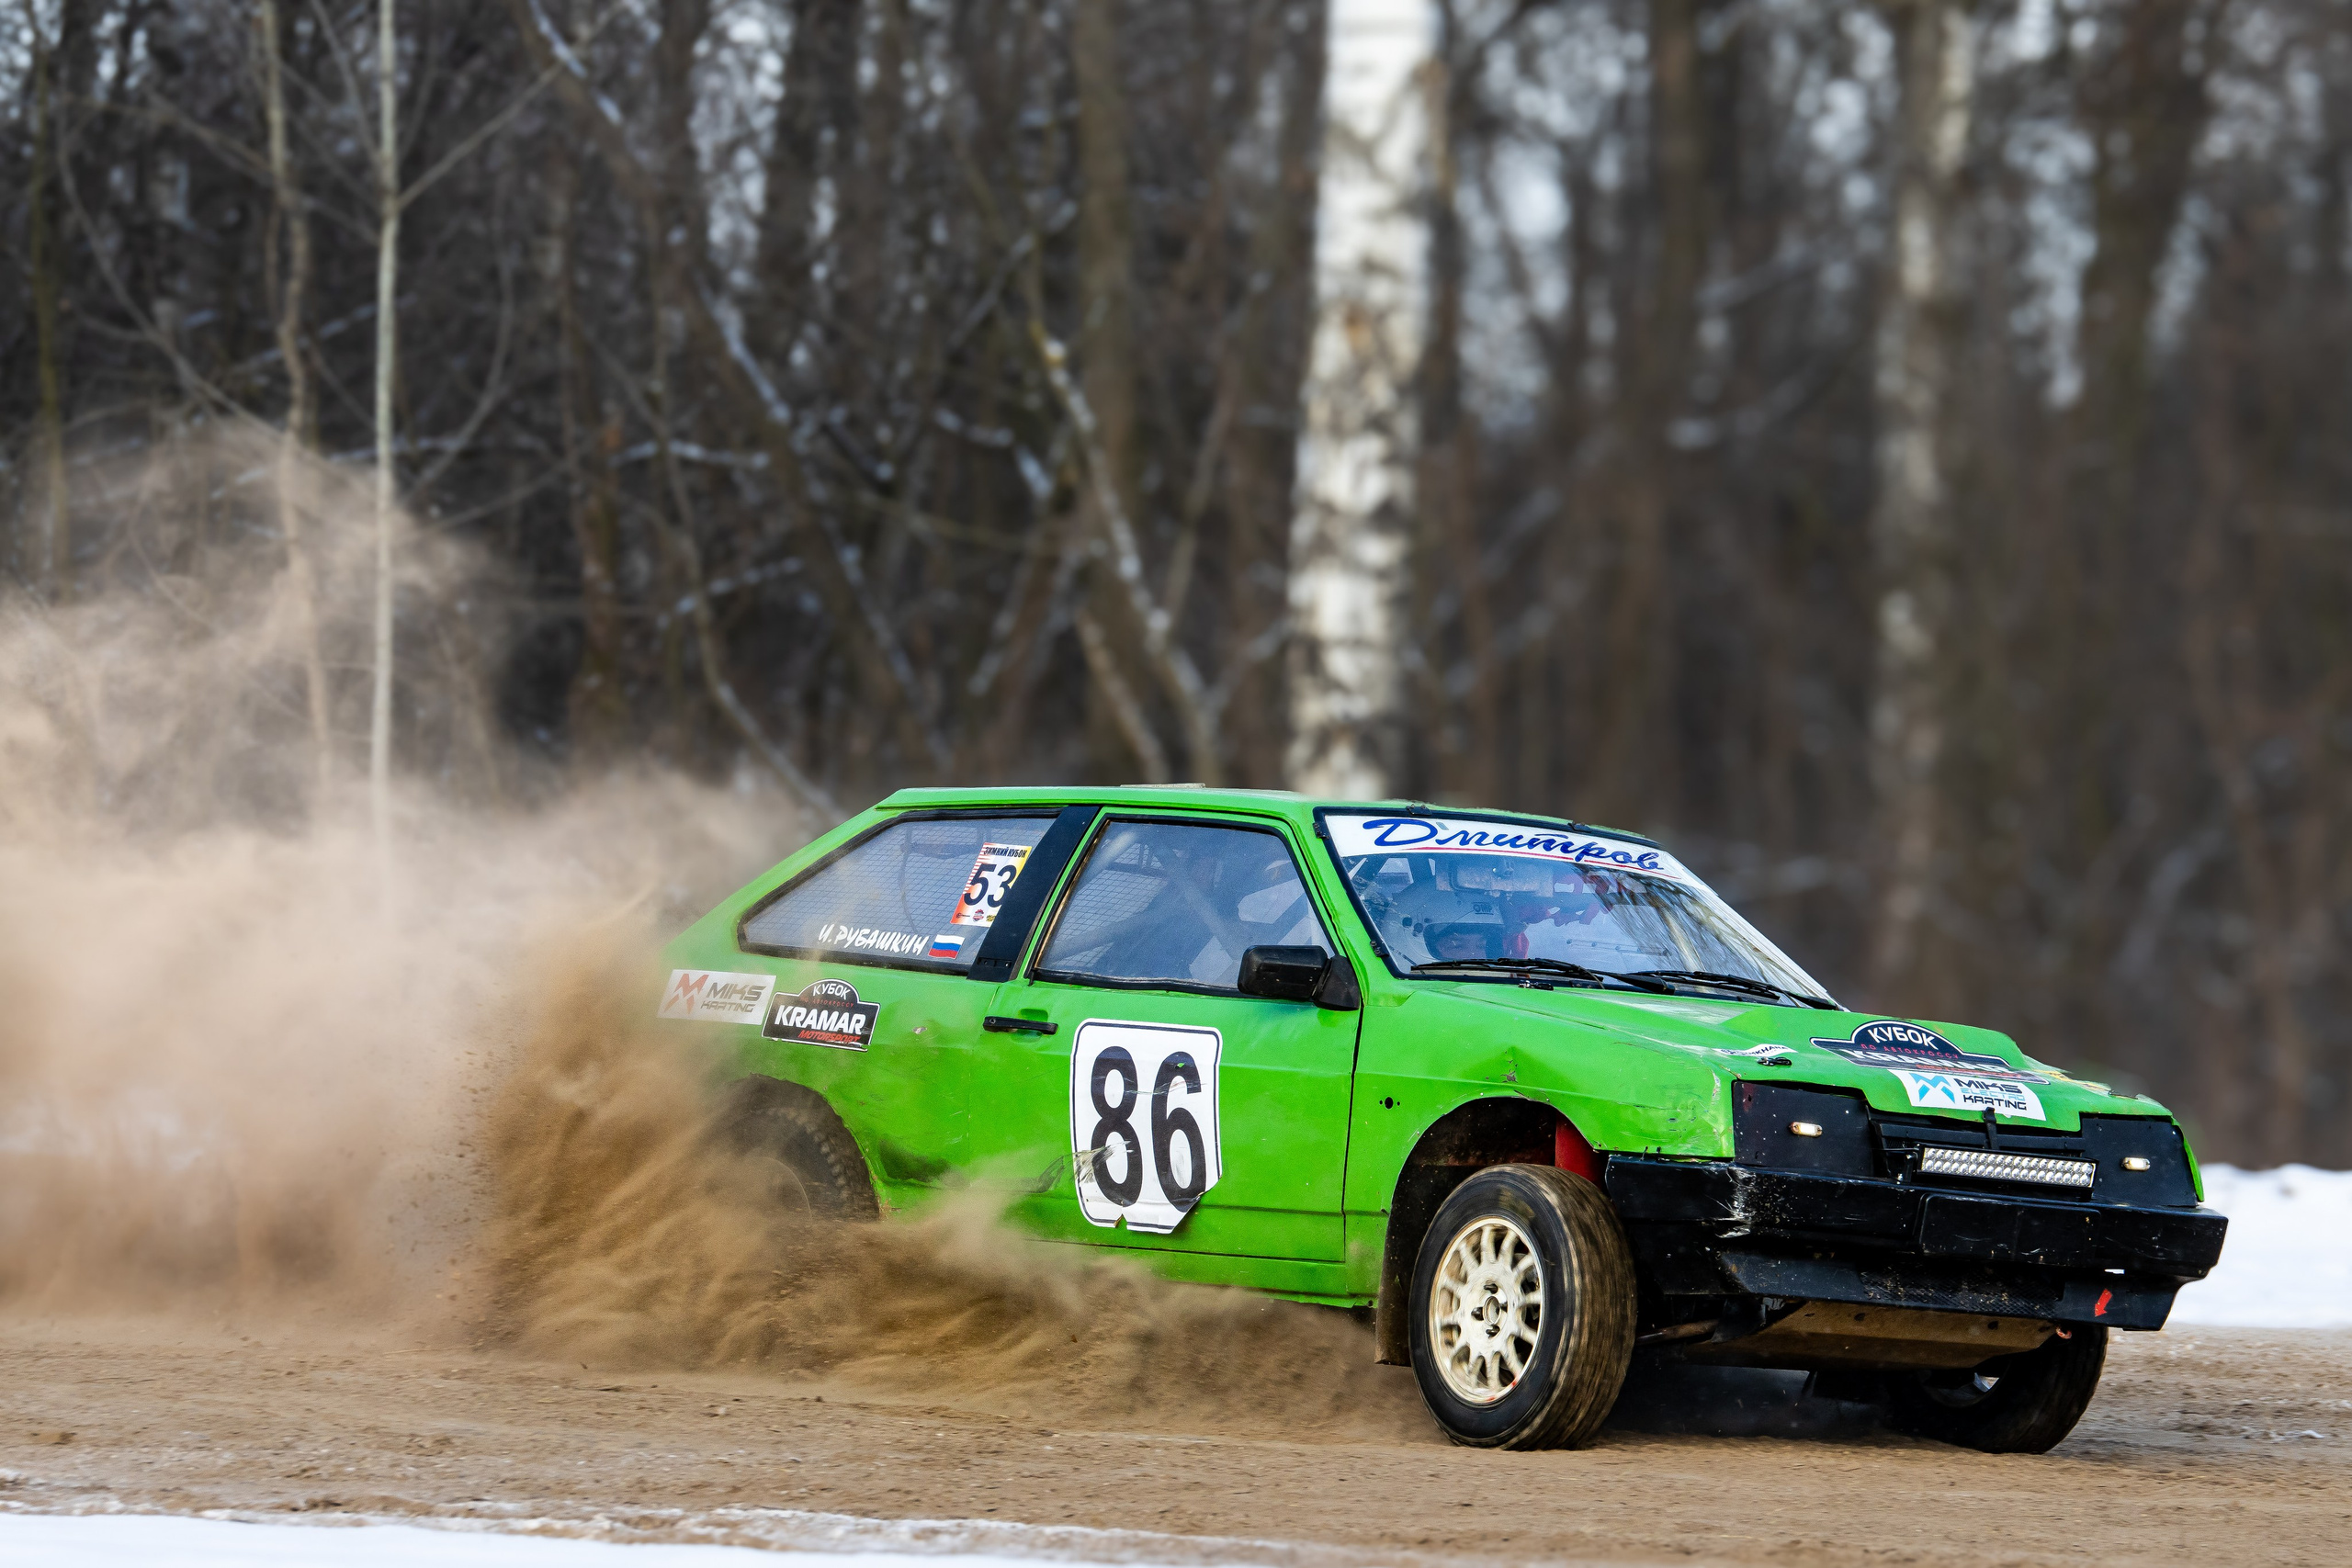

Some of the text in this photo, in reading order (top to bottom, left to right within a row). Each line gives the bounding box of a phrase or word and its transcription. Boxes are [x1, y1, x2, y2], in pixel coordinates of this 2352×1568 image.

[963, 863, 1017, 908] 53
[833, 925, 930, 955] РУБАШКИН
[706, 982, 766, 1002] MIKS
[812, 983, 851, 1000] КУБОК
[700, 1000, 757, 1013] KARTING
[775, 1005, 866, 1035] KRAMAR
[797, 1030, 861, 1043] MOTORSPORT
[1868, 1027, 1939, 1050] КУБОК
[1839, 1048, 2016, 1073] KRAMAR
[1883, 1046, 1959, 1059] АВТОКРОССУ
[1953, 1077, 2023, 1094] MIKS
[1961, 1088, 2026, 1101] ELECTRO
[1963, 1094, 2028, 1111] KARTING
[1091, 1045, 1206, 1213] 86
